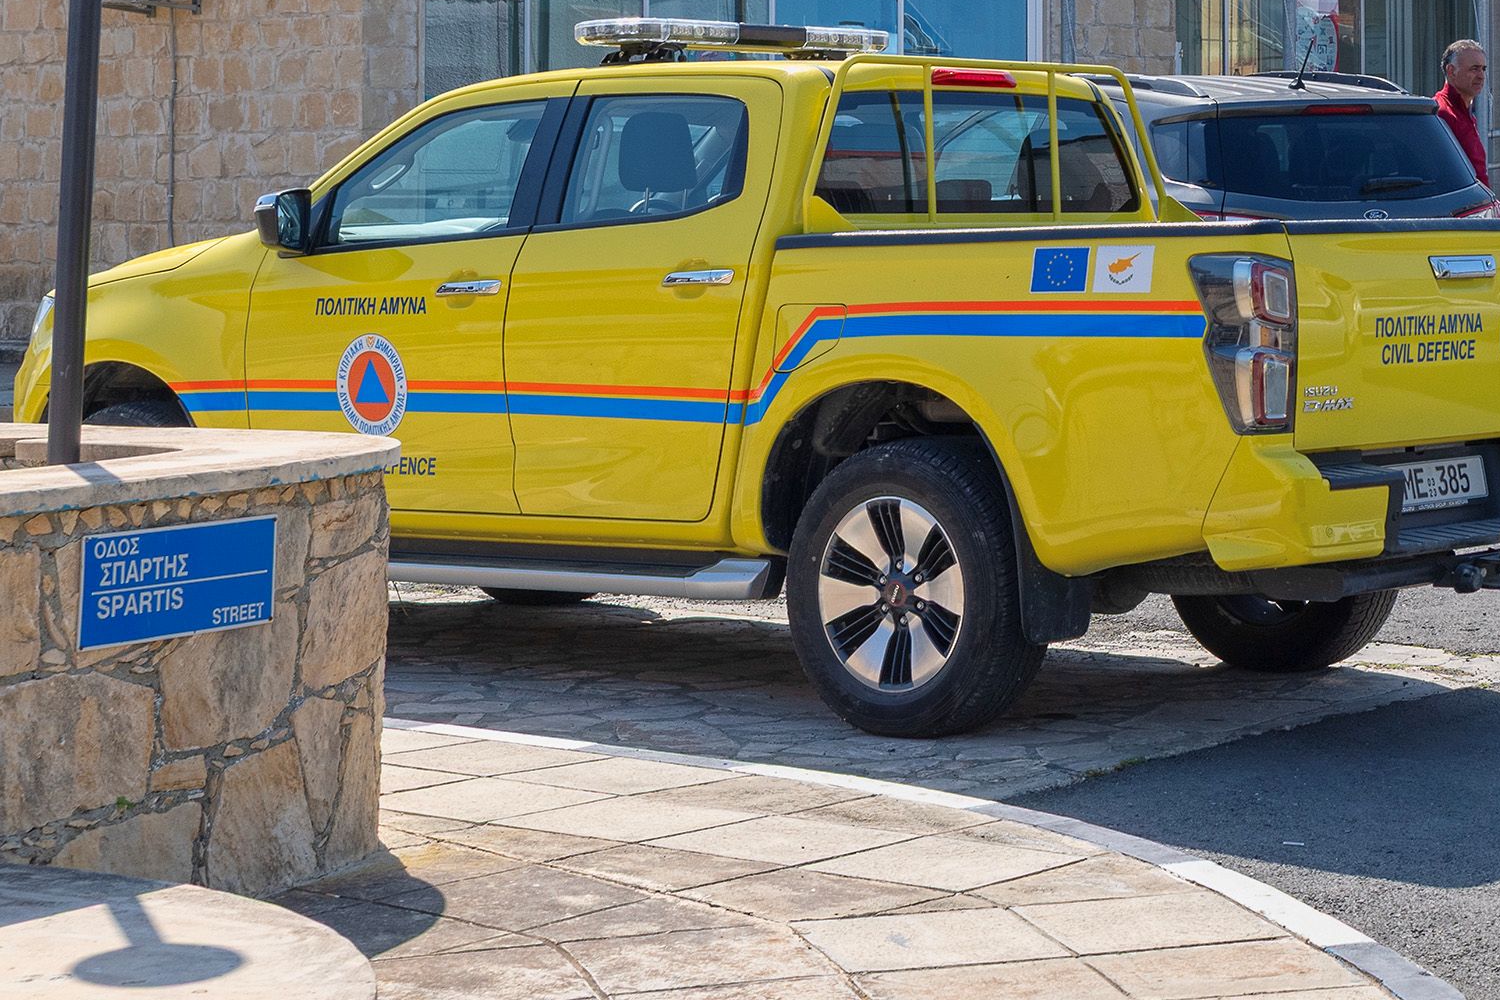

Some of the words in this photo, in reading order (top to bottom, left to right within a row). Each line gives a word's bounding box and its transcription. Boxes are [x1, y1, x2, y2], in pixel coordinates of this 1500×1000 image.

[315, 297, 376, 316] ΠΟΛΙΤΙΚΗ
[378, 296, 427, 315] ΑΜΥΝΑ
[1375, 315, 1435, 338] ΠΟΛΙΤΙΚΗ
[1438, 312, 1483, 335] ΑΜΥΝΑ
[1381, 343, 1413, 365] CIVIL
[1417, 339, 1476, 363] DEFENCE
[1304, 385, 1338, 397] ISUZU
[1435, 463, 1470, 495] 385
[94, 537, 140, 560] ΟΔΟΣ
[99, 553, 190, 587] ΣΠΑΡΤΗΣ
[96, 587, 184, 620] SPARTIS
[212, 602, 265, 625] STREET
